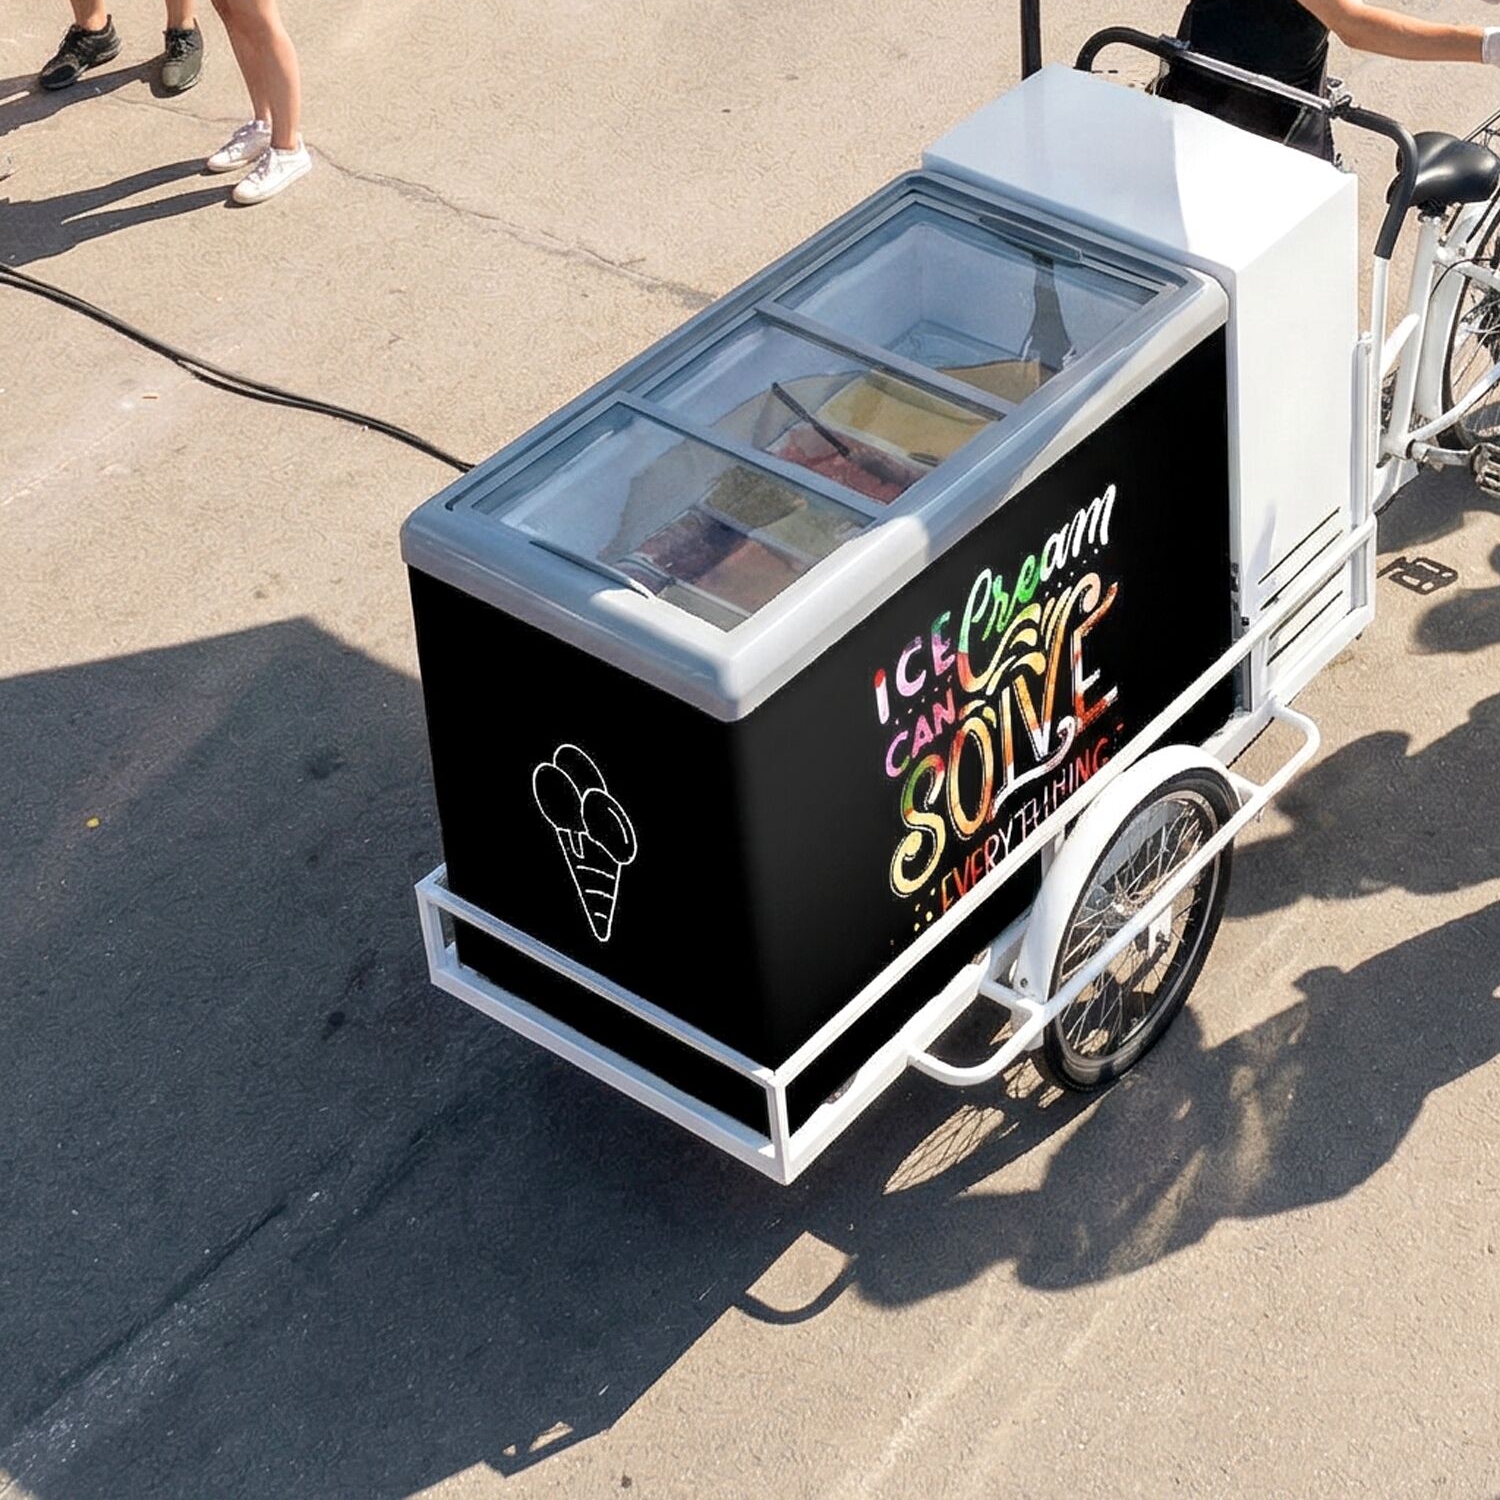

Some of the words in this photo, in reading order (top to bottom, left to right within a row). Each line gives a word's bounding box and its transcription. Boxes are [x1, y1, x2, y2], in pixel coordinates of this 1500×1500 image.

[874, 611, 956, 724] ICE
[957, 484, 1117, 693] Cream
[885, 688, 956, 778] CAN
[889, 572, 1119, 898] SOLVE
